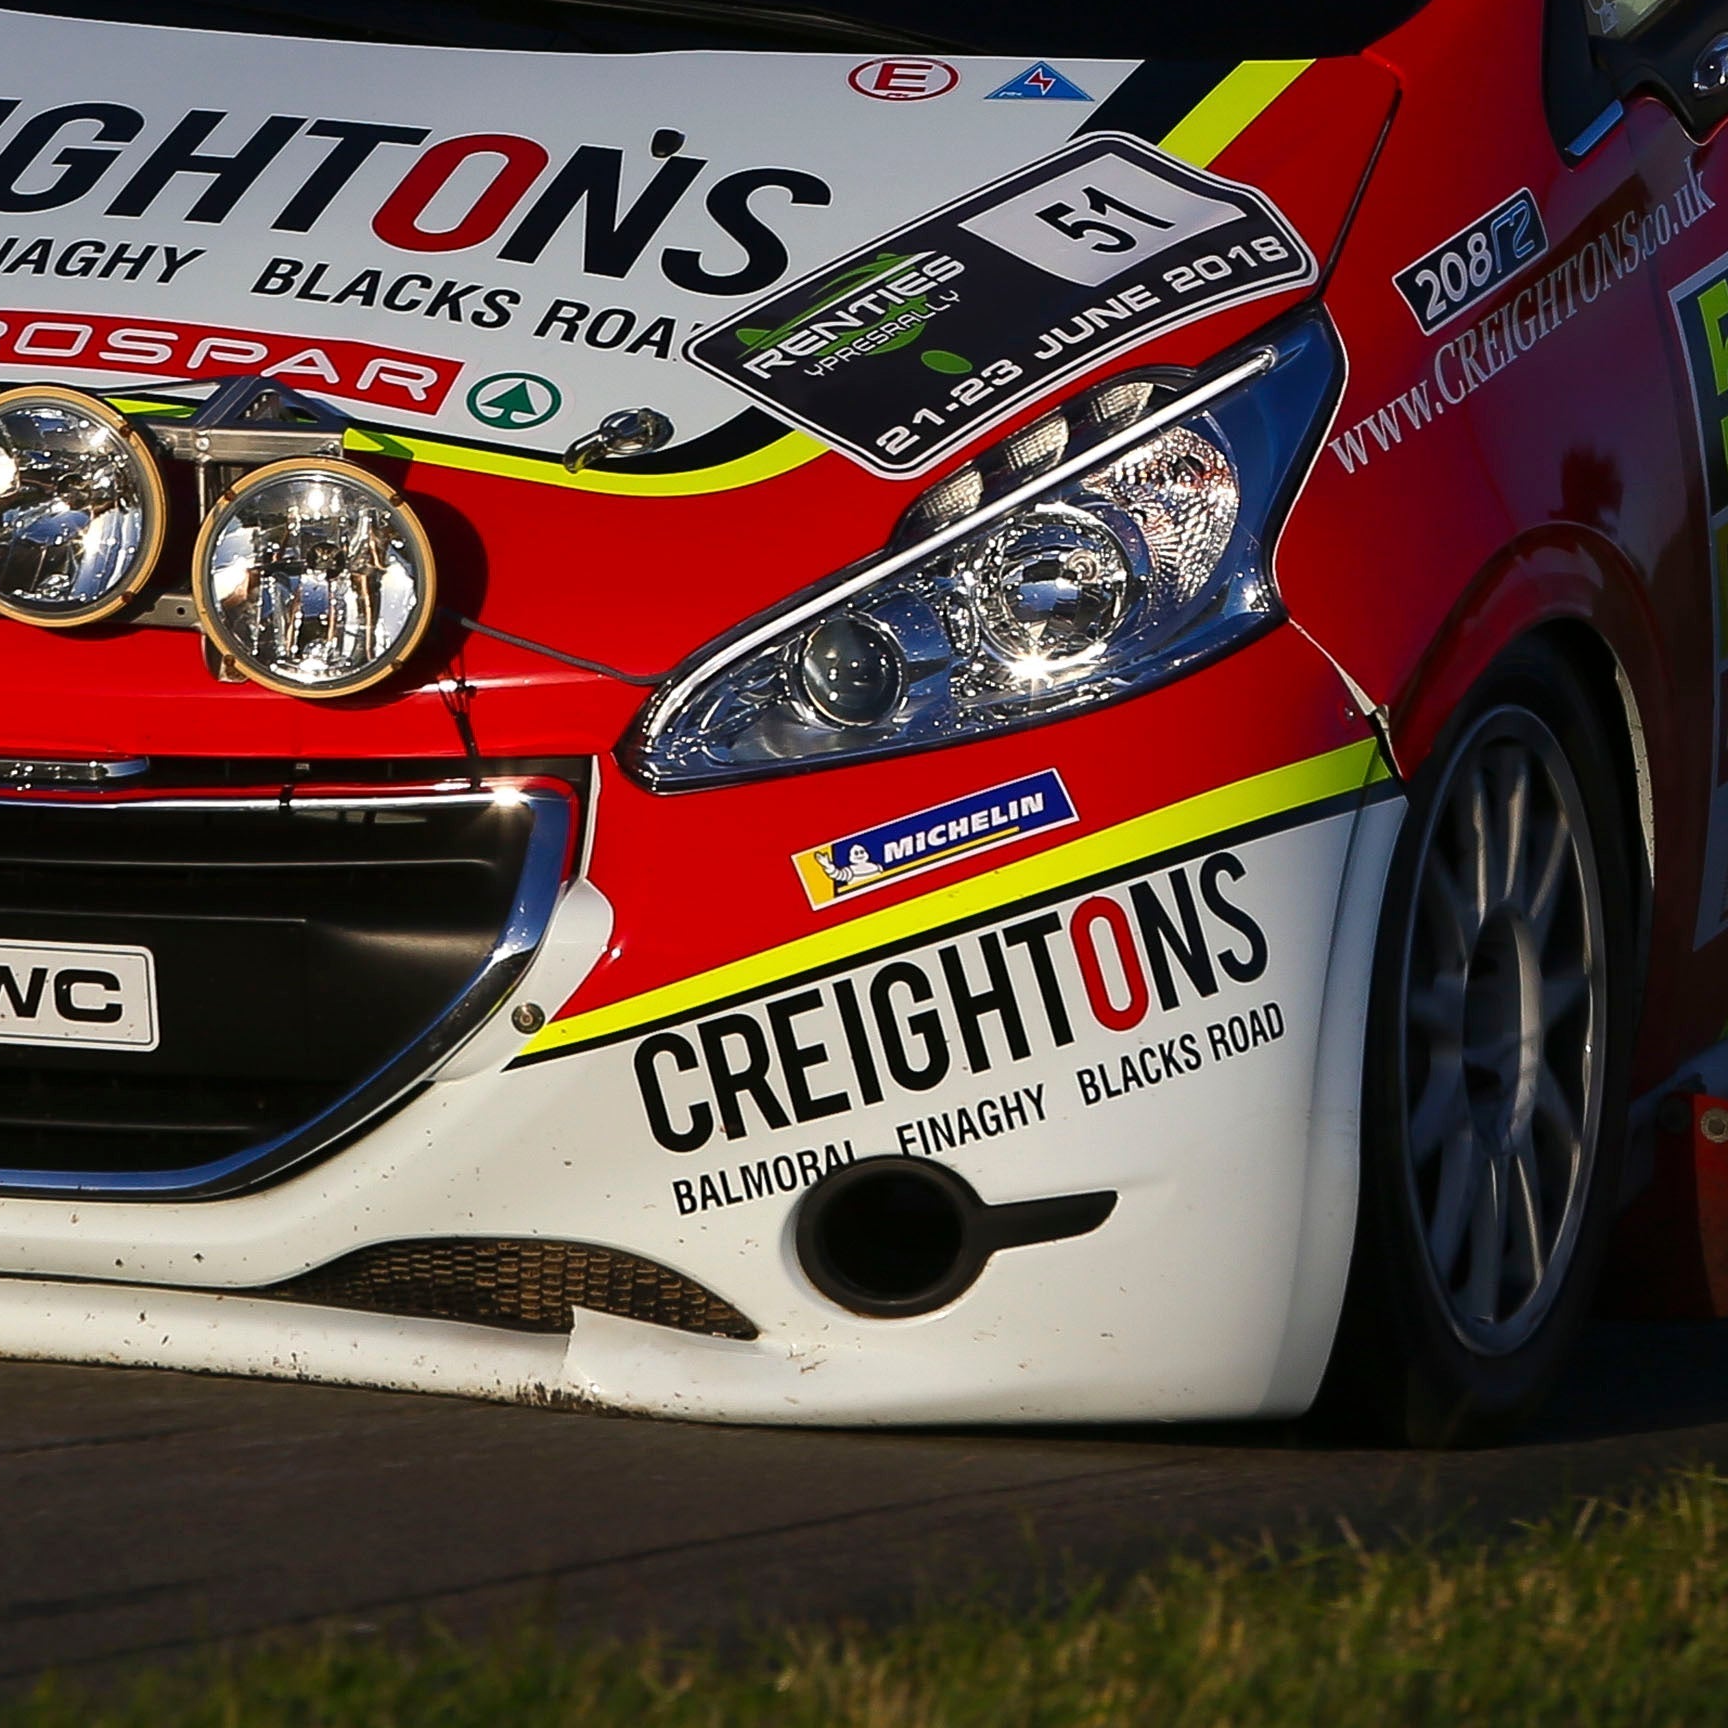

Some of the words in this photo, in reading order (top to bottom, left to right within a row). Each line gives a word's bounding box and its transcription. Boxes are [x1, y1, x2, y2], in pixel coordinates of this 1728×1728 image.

[1034, 185, 1177, 256] 51
[250, 258, 522, 330] BLACKS
[534, 297, 704, 361] ROA
[742, 252, 967, 379] RENTIES
[802, 289, 963, 378] YPRESRALLY
[876, 358, 1025, 455] 21-23
[1033, 283, 1162, 362] JUNE
[1162, 235, 1290, 294] 2018
[882, 791, 1046, 864] MICHELIN
[633, 852, 1269, 1154] CREIGHTONS
[896, 1083, 1050, 1157] FINAGHY
[1076, 1034, 1203, 1107] BLACKS
[1205, 1000, 1286, 1061] ROAD
